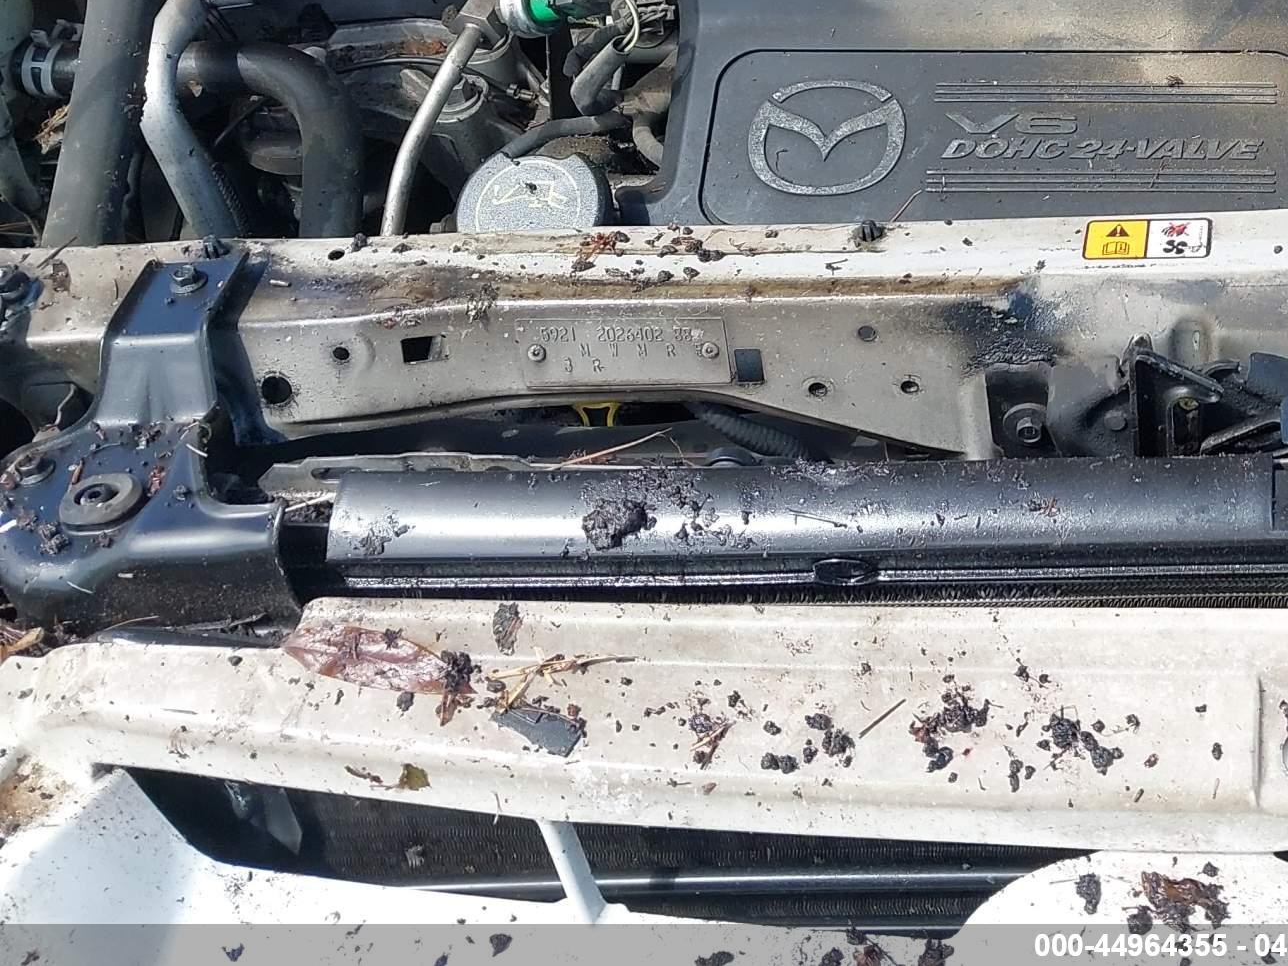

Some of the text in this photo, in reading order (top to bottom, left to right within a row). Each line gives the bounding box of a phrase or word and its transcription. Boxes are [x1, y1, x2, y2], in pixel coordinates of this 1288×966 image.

[945, 113, 1079, 135] V6
[941, 137, 1265, 161] DOHC 24-VALVE
[540, 326, 576, 342] 5921
[596, 325, 664, 342] 2026402
[666, 343, 677, 358] R
